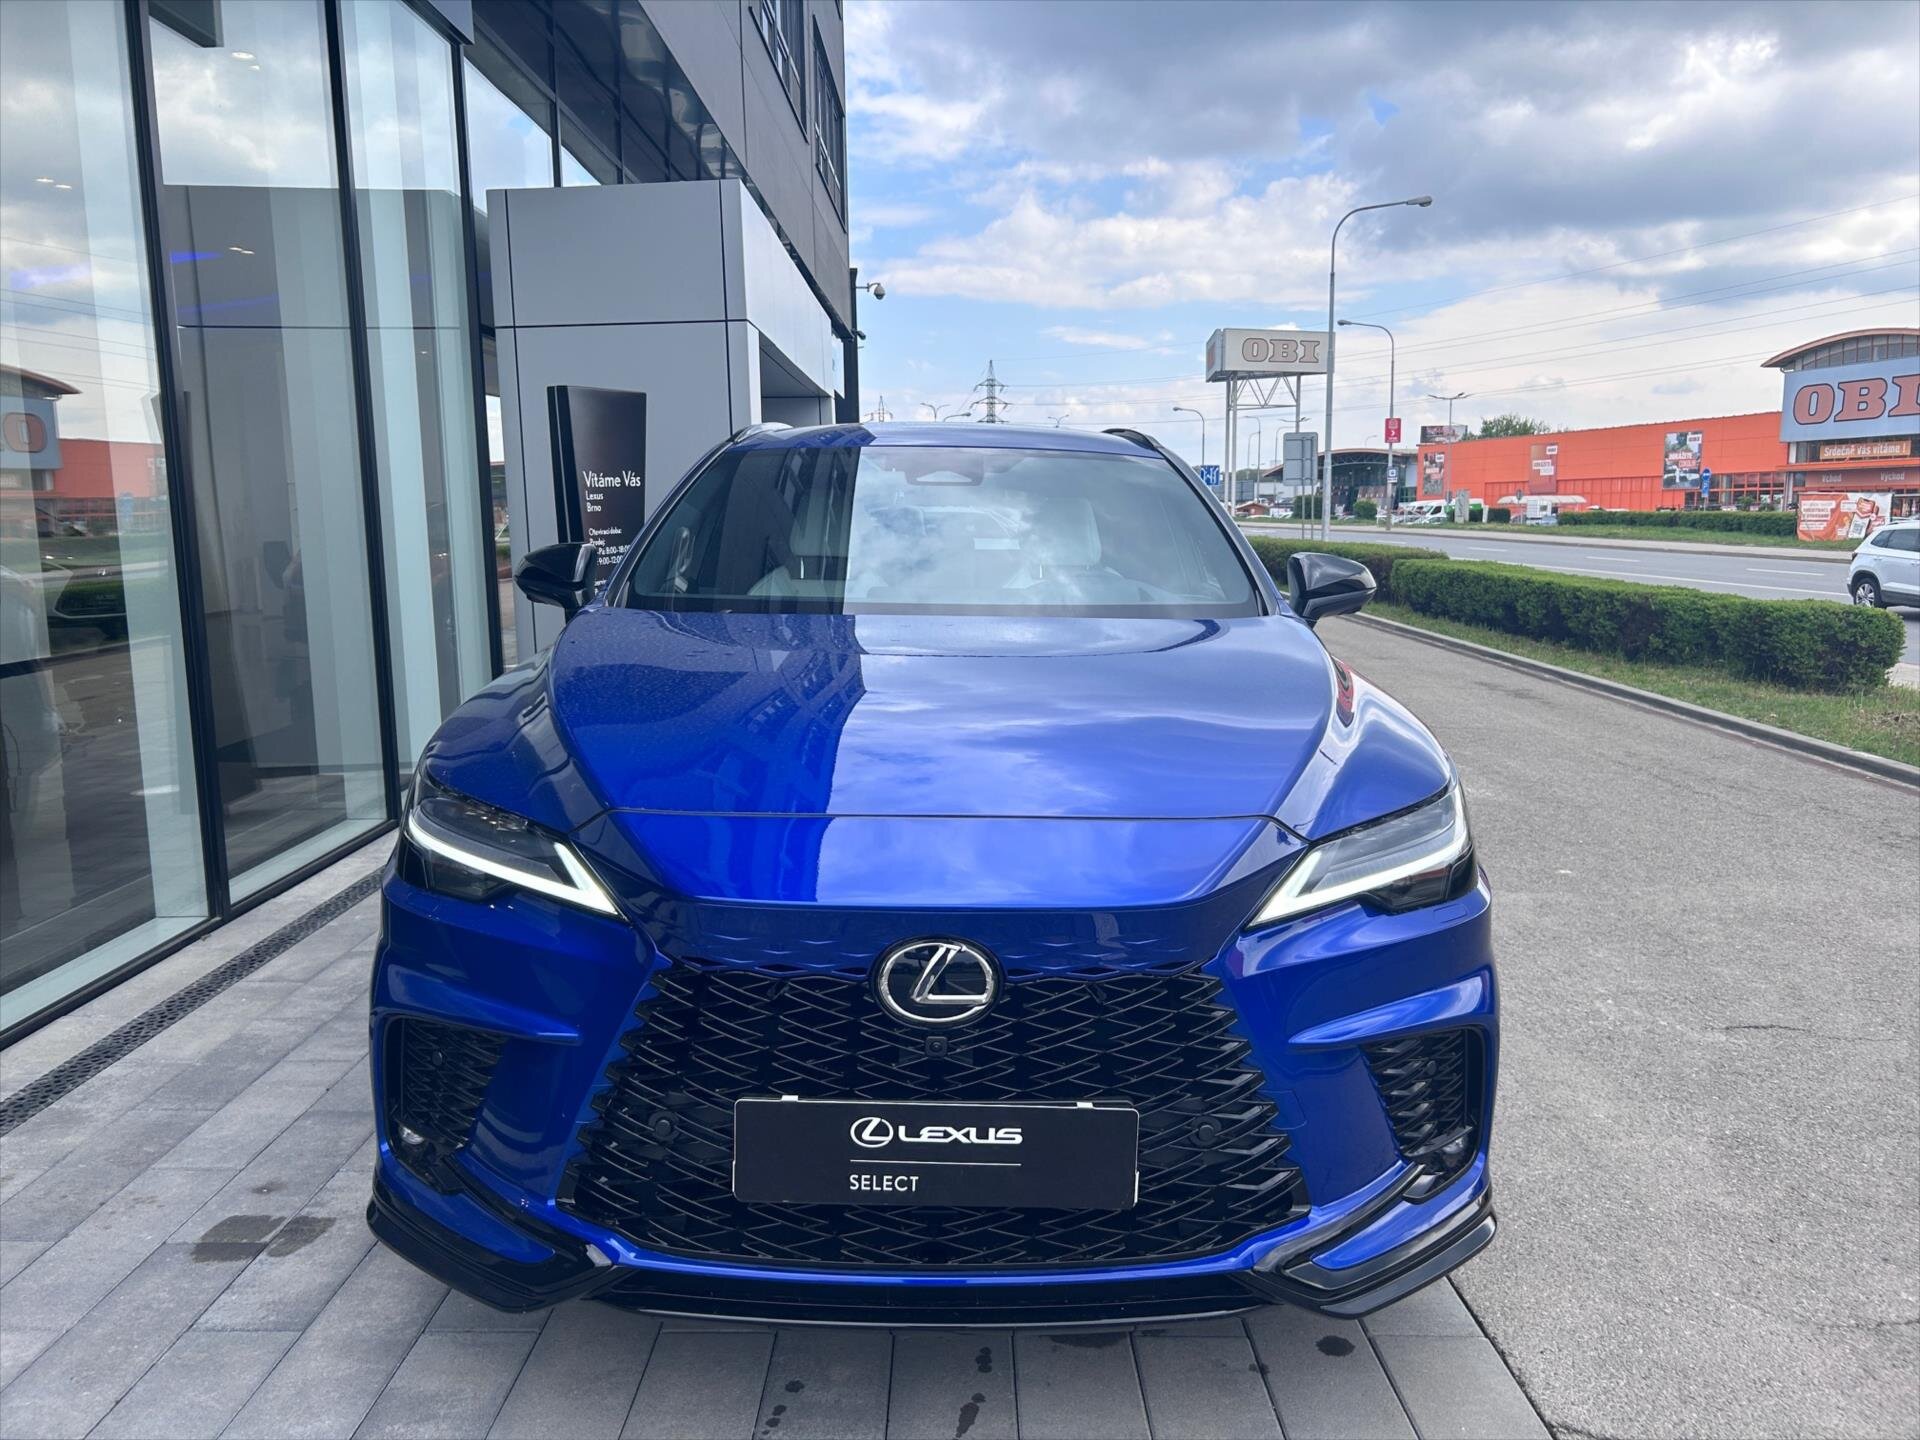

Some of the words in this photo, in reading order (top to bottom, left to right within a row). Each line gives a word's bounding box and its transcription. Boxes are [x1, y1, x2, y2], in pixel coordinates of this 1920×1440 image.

[1242, 338, 1320, 363] OBI
[582, 470, 621, 488] Vítáme
[622, 470, 641, 487] Vás
[585, 490, 604, 500] Lexus
[586, 502, 602, 512] Brno
[898, 1125, 1023, 1144] LEXUS
[849, 1174, 919, 1192] SELECT
